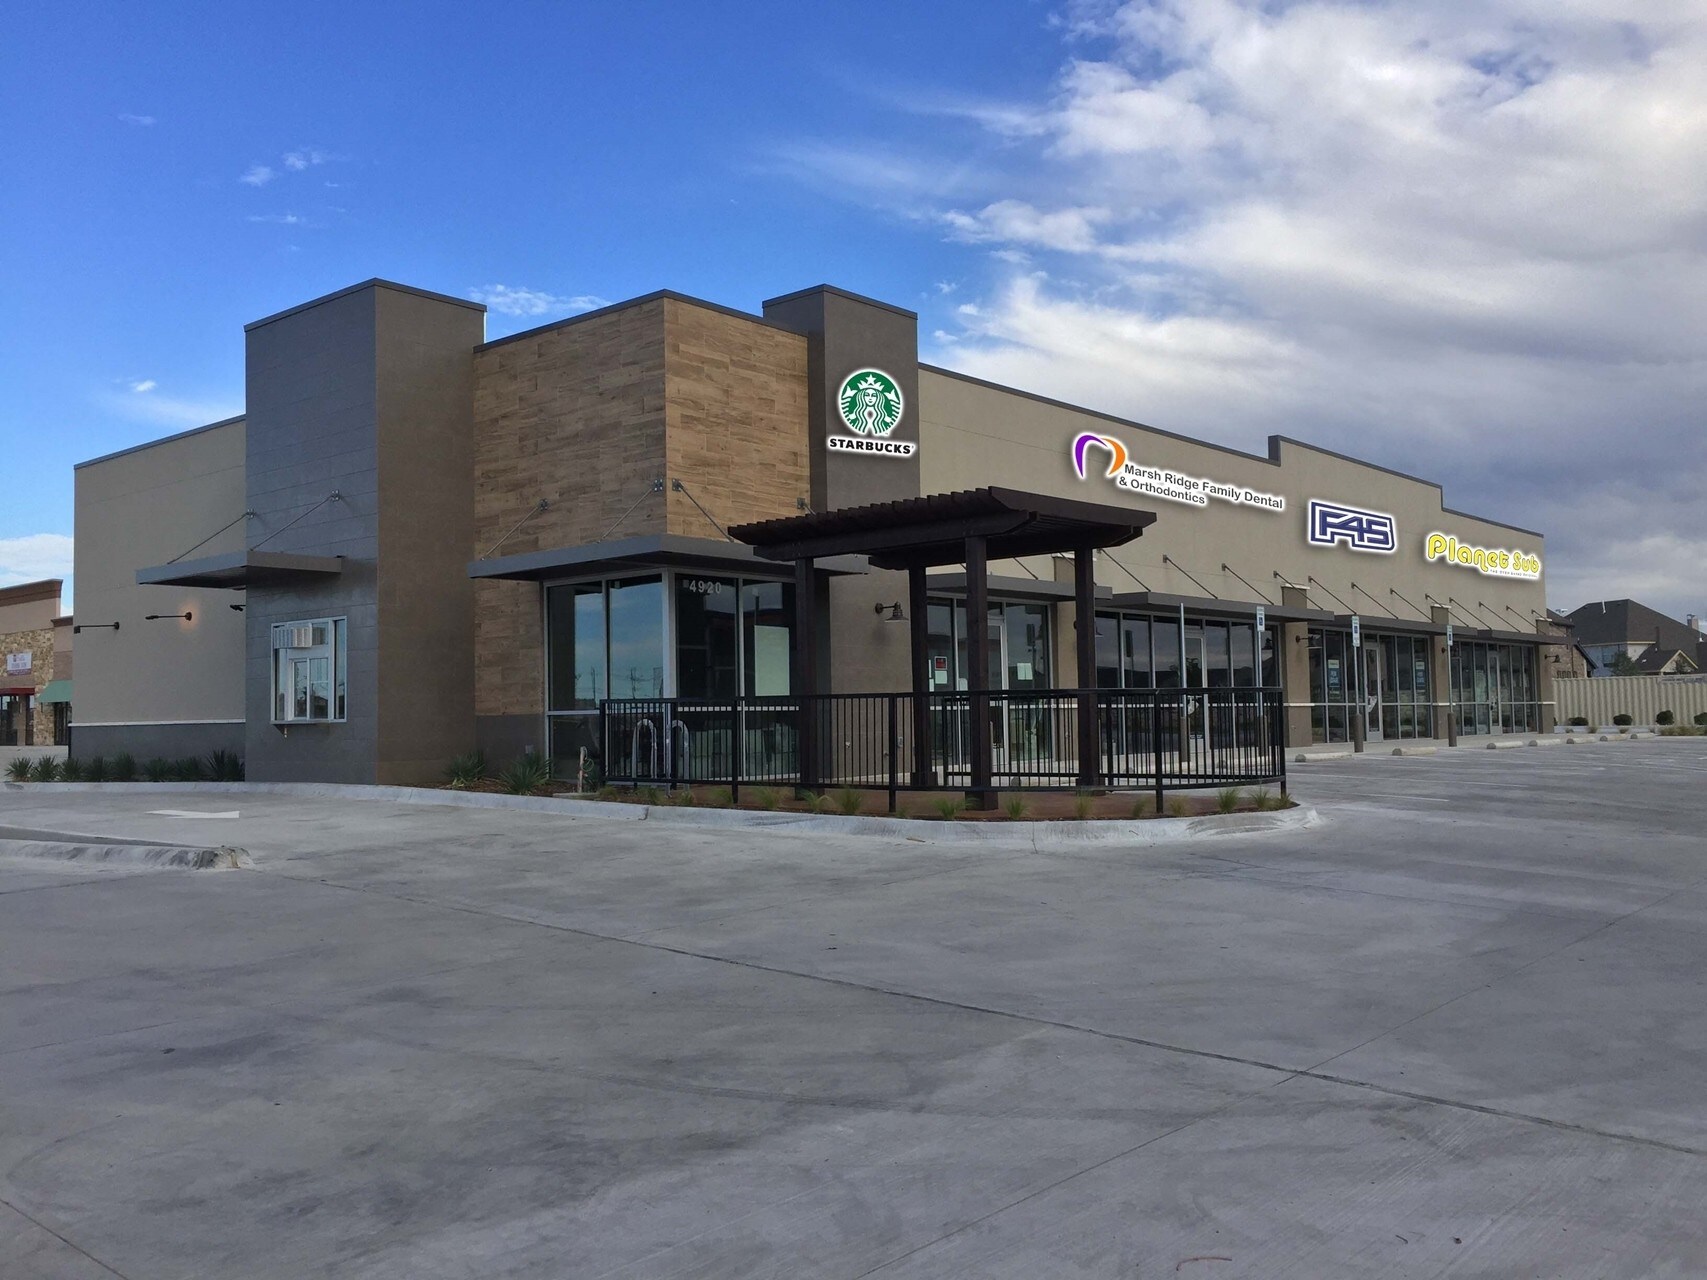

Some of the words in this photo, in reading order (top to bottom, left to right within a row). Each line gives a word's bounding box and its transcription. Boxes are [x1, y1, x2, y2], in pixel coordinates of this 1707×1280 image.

[829, 438, 911, 455] STARBUCKS
[1119, 476, 1128, 486] &
[1130, 478, 1206, 504] Orthodontics
[1124, 463, 1162, 481] Marsh
[1164, 472, 1199, 490] Ridge
[1202, 482, 1241, 501] Family
[1244, 491, 1283, 509] Dental
[1318, 508, 1391, 545] F45
[1427, 533, 1510, 573] Planet
[1512, 551, 1540, 574] Sub
[689, 580, 722, 594] 4920
